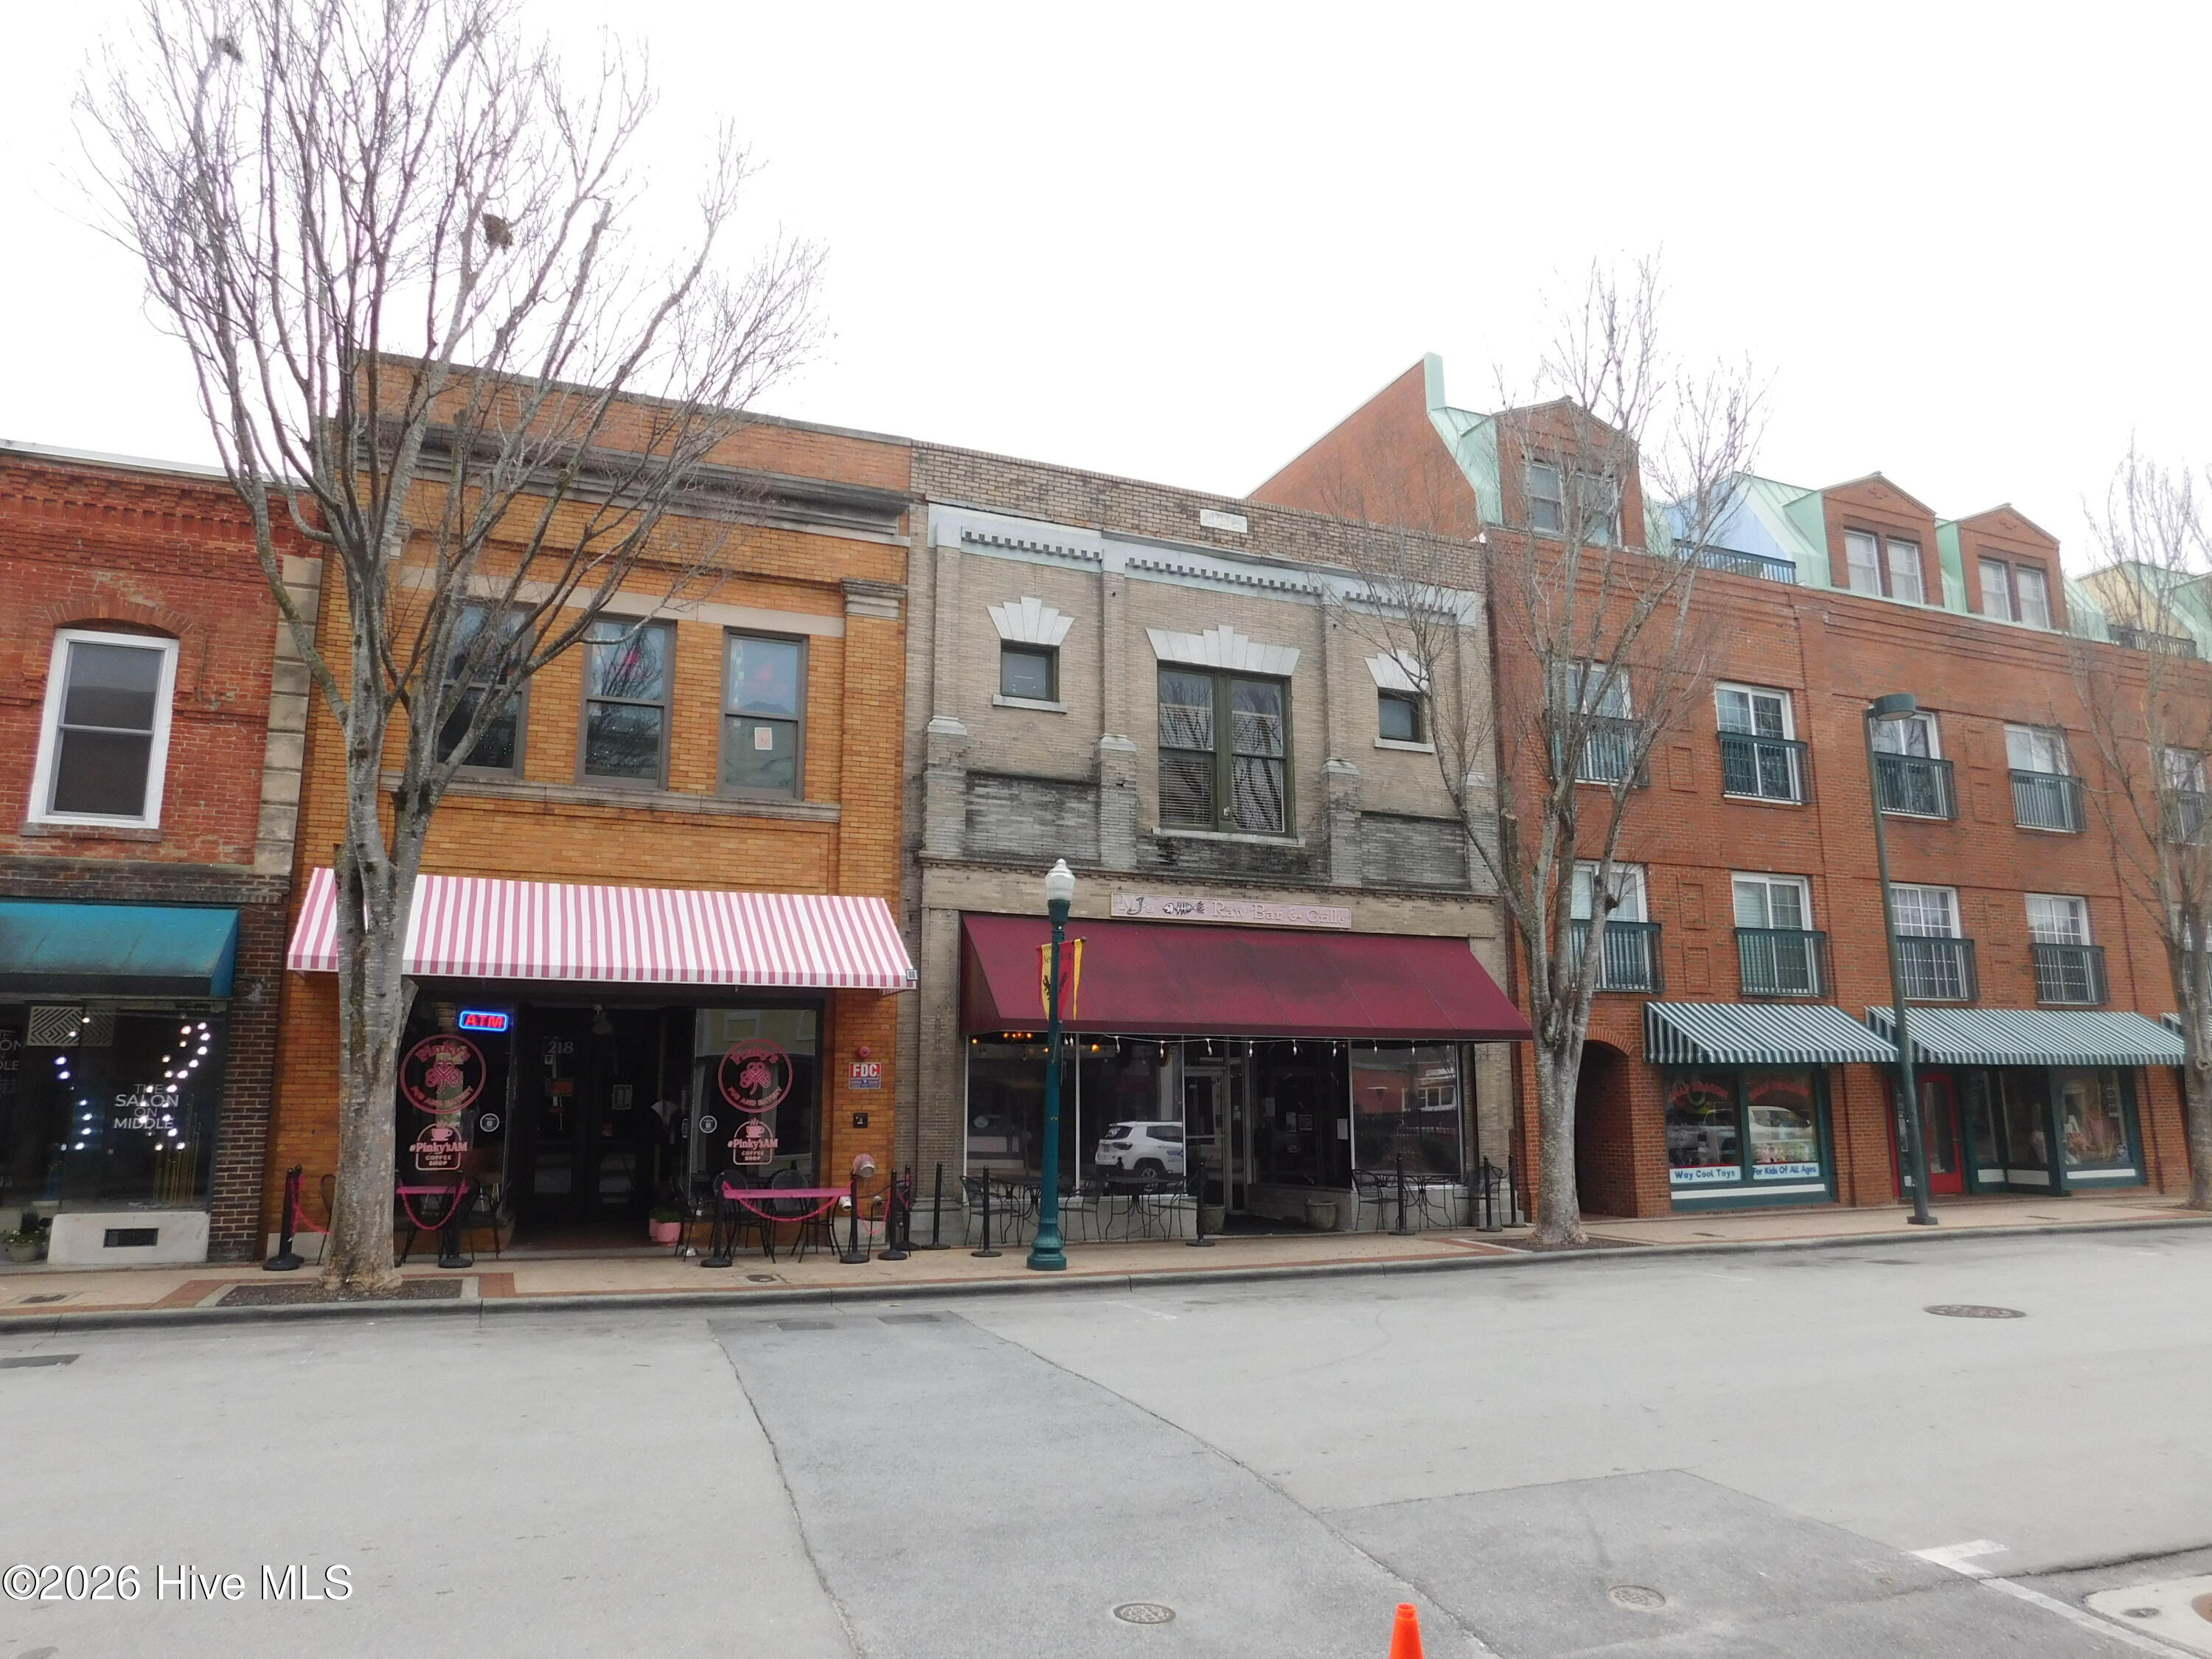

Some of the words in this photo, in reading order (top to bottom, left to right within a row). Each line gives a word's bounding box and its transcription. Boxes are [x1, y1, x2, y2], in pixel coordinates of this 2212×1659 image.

[1213, 902, 1248, 918] Raw
[1251, 905, 1282, 921] Bar
[1289, 908, 1302, 922] &
[1307, 908, 1346, 923] Grille
[465, 1014, 503, 1029] ATM
[548, 1041, 574, 1054] 218
[853, 1064, 877, 1077] FDC
[133, 1084, 164, 1094] THE
[114, 1094, 179, 1107] SALON
[134, 1107, 158, 1117] ON
[114, 1118, 174, 1129] MIDDLE
[1674, 1171, 1693, 1180] Way
[1696, 1169, 1714, 1178] Cool
[1717, 1169, 1735, 1179] Toys
[1764, 1166, 1778, 1175] Kids
[1779, 1166, 1788, 1174] Of
[1801, 1165, 1816, 1175] Ages
